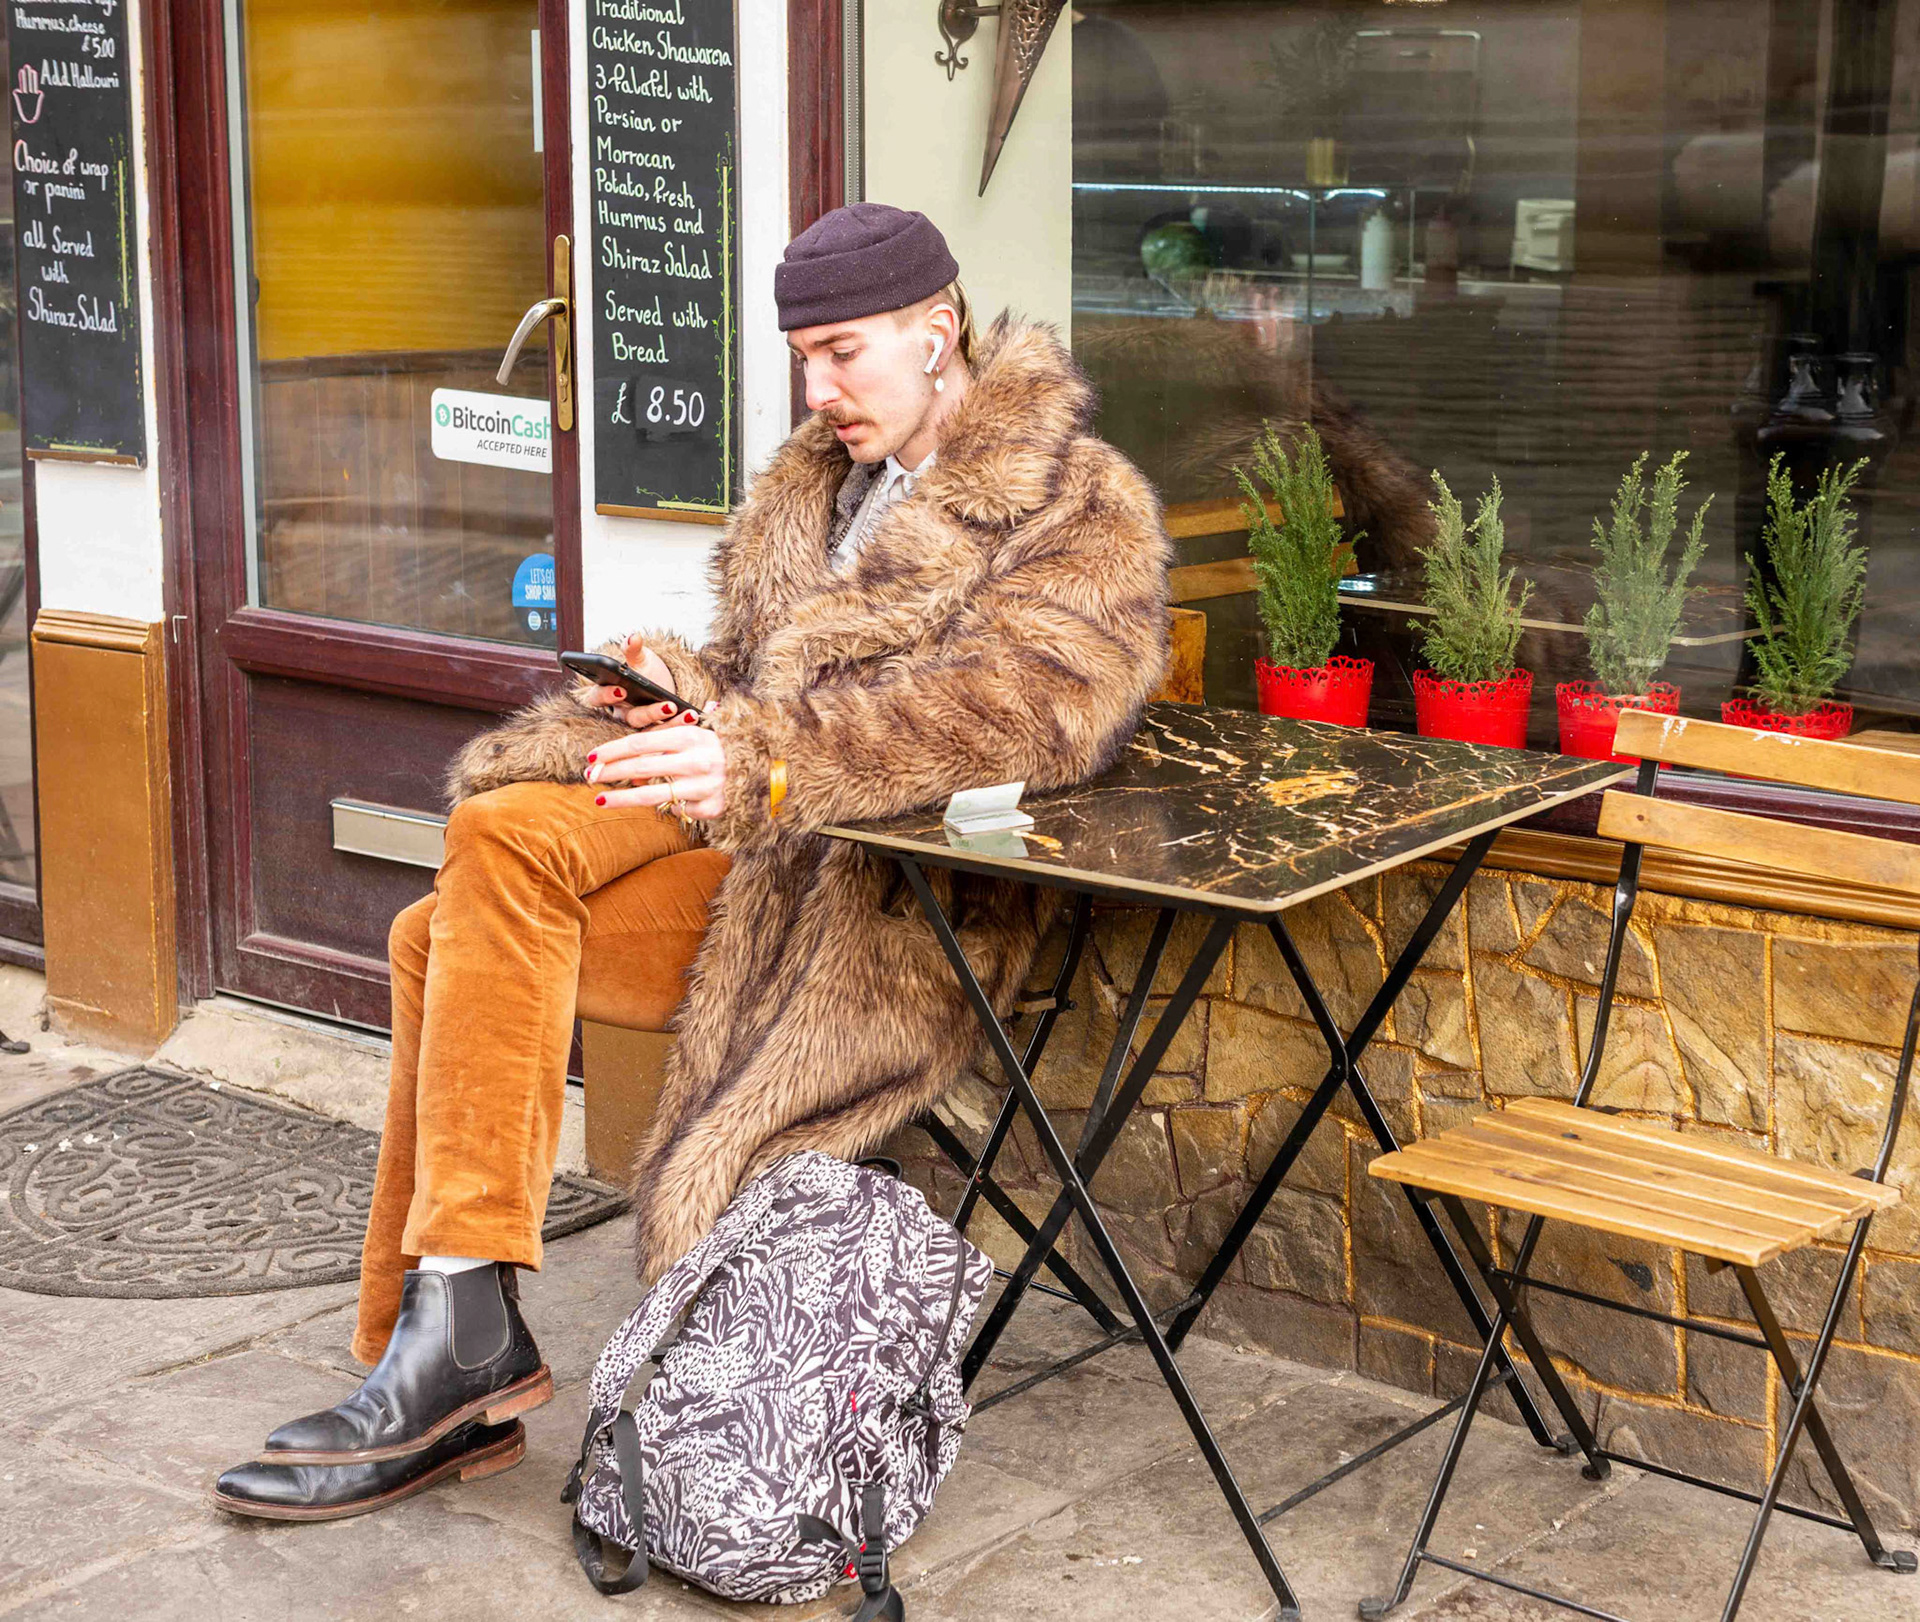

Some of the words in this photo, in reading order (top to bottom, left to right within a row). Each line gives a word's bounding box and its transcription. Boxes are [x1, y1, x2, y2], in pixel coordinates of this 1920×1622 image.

[593, 26, 654, 56] Chicken
[41, 59, 71, 87] Add
[595, 64, 607, 89] 3
[677, 75, 713, 103] with
[594, 95, 656, 132] Persian
[661, 118, 682, 132] or
[14, 139, 59, 174] Choice
[62, 147, 78, 175] of
[80, 161, 109, 191] wrap
[597, 136, 675, 170] Morrocan
[24, 180, 39, 195] or
[45, 182, 86, 214] panini
[595, 168, 650, 201] Potato,
[598, 200, 666, 233] Hummus
[674, 208, 704, 235] and
[52, 225, 95, 258] Served
[602, 236, 661, 273] Shiraz
[664, 241, 712, 280] Salad
[41, 260, 70, 284] with
[28, 286, 78, 327] Shiraz
[77, 294, 117, 333] Salad
[605, 290, 664, 327] Served
[672, 301, 708, 328] with
[612, 332, 669, 363] Bread
[477, 439, 522, 455] ACCEPTED
[523, 445, 548, 458] HERE
[525, 584, 542, 600] SHOP
